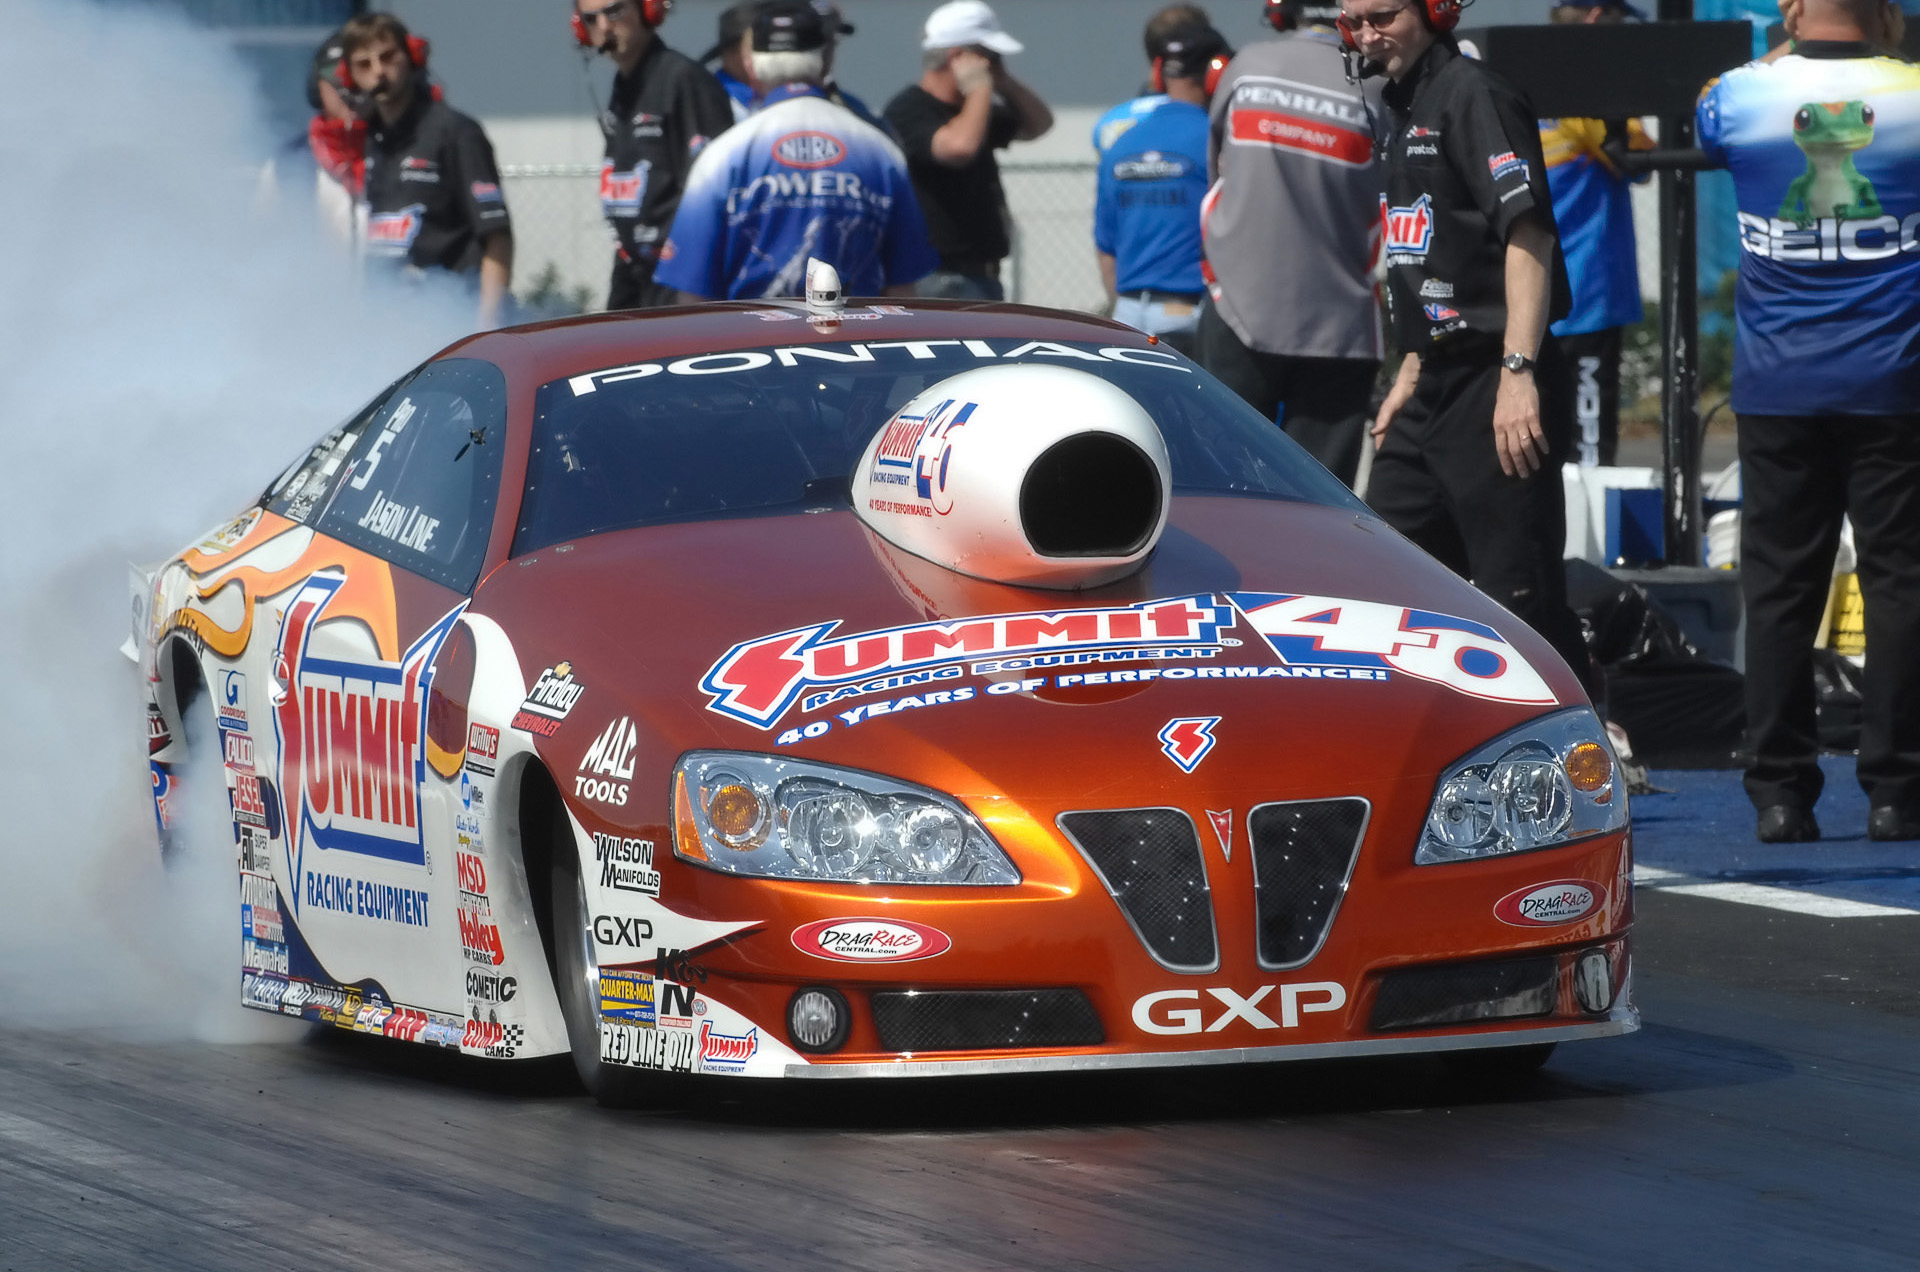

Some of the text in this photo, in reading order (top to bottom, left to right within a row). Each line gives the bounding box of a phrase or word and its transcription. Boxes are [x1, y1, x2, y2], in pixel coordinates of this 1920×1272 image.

[1236, 86, 1370, 128] PENHALL
[779, 135, 840, 161] NHRA
[1258, 119, 1337, 148] COMPANY
[568, 338, 1192, 398] PONTIAC
[350, 428, 397, 491] 5
[358, 489, 441, 553] JASON LINE
[893, 502, 933, 518] PERFORMANCE!
[804, 648, 1222, 712] RACING EQUIPMENT
[220, 705, 246, 720] GOODRIDGE
[775, 666, 1390, 746] 40 YEARS OF PERFORMANCE!
[512, 711, 562, 738] CHEVROLET
[226, 735, 255, 767] CALICO
[579, 716, 637, 781] MAC
[233, 776, 265, 815] JESEL
[575, 775, 630, 806] TOOLS
[594, 832, 653, 865] WILSON
[456, 851, 487, 894] MSD
[601, 861, 660, 889] MANIFOLDS
[307, 871, 353, 914] RACING
[357, 880, 429, 927] EQUIPMENT
[1535, 908, 1580, 918] CENTRAL.com
[593, 915, 653, 947] GXP
[472, 950, 493, 965] CARBS
[835, 946, 897, 954] CENTRAL.com
[466, 971, 518, 1003] COMETIC
[600, 977, 655, 1003] QUARTER-MAX
[284, 1005, 302, 1017] RACING
[1132, 981, 1347, 1035] GXP
[463, 1019, 503, 1049] COMP
[600, 1022, 694, 1072] RED LINE OIL
[484, 1045, 515, 1058] CAMS
[704, 1064, 745, 1073] RACING EQUIPMENT
